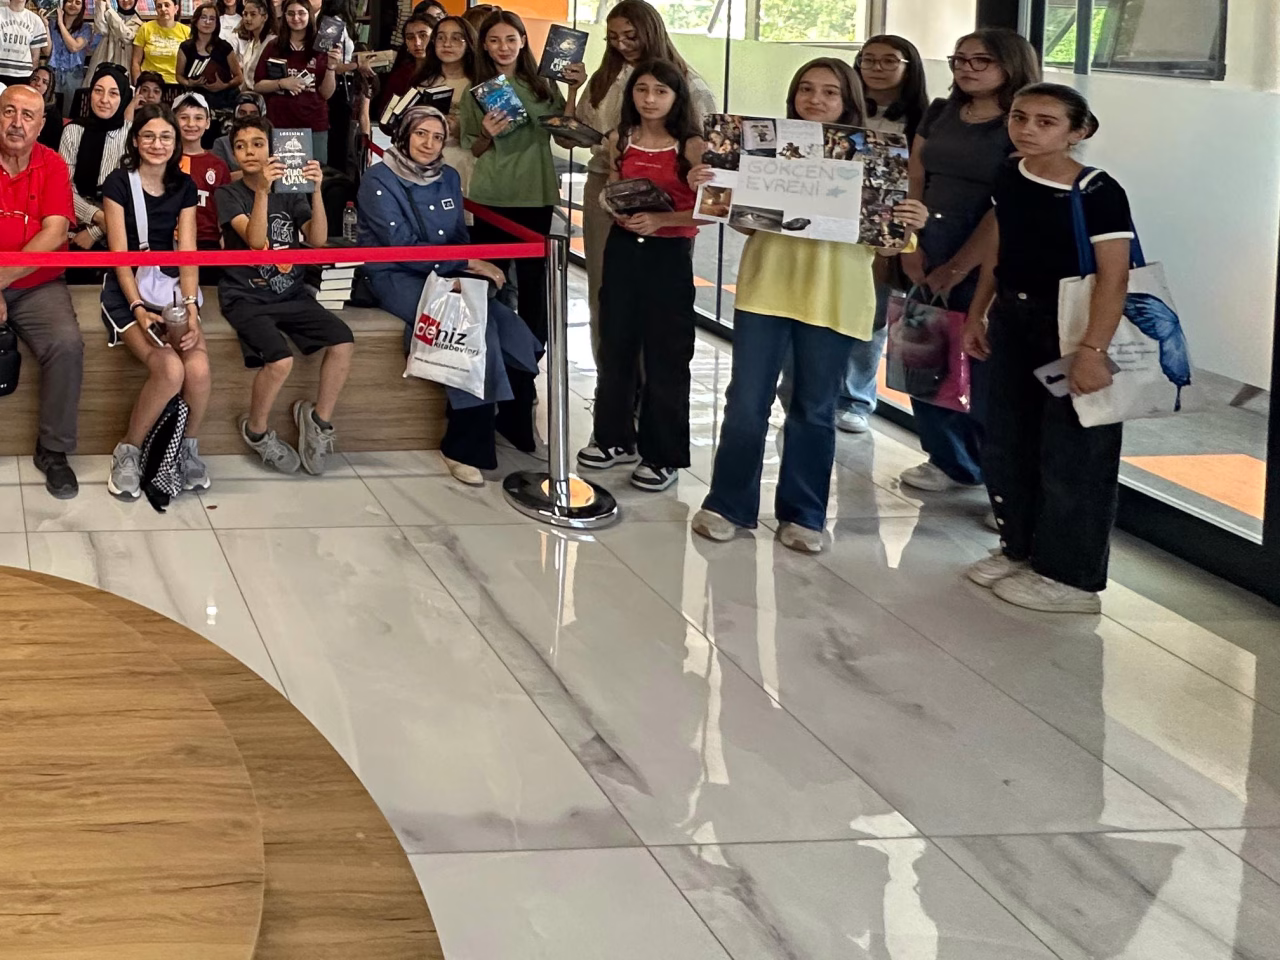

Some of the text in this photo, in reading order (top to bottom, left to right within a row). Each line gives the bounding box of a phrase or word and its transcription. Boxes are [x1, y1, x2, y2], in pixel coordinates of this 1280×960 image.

[3, 32, 28, 46] SEOUL
[415, 320, 468, 346] deniz
[433, 341, 480, 356] kitabevleri
